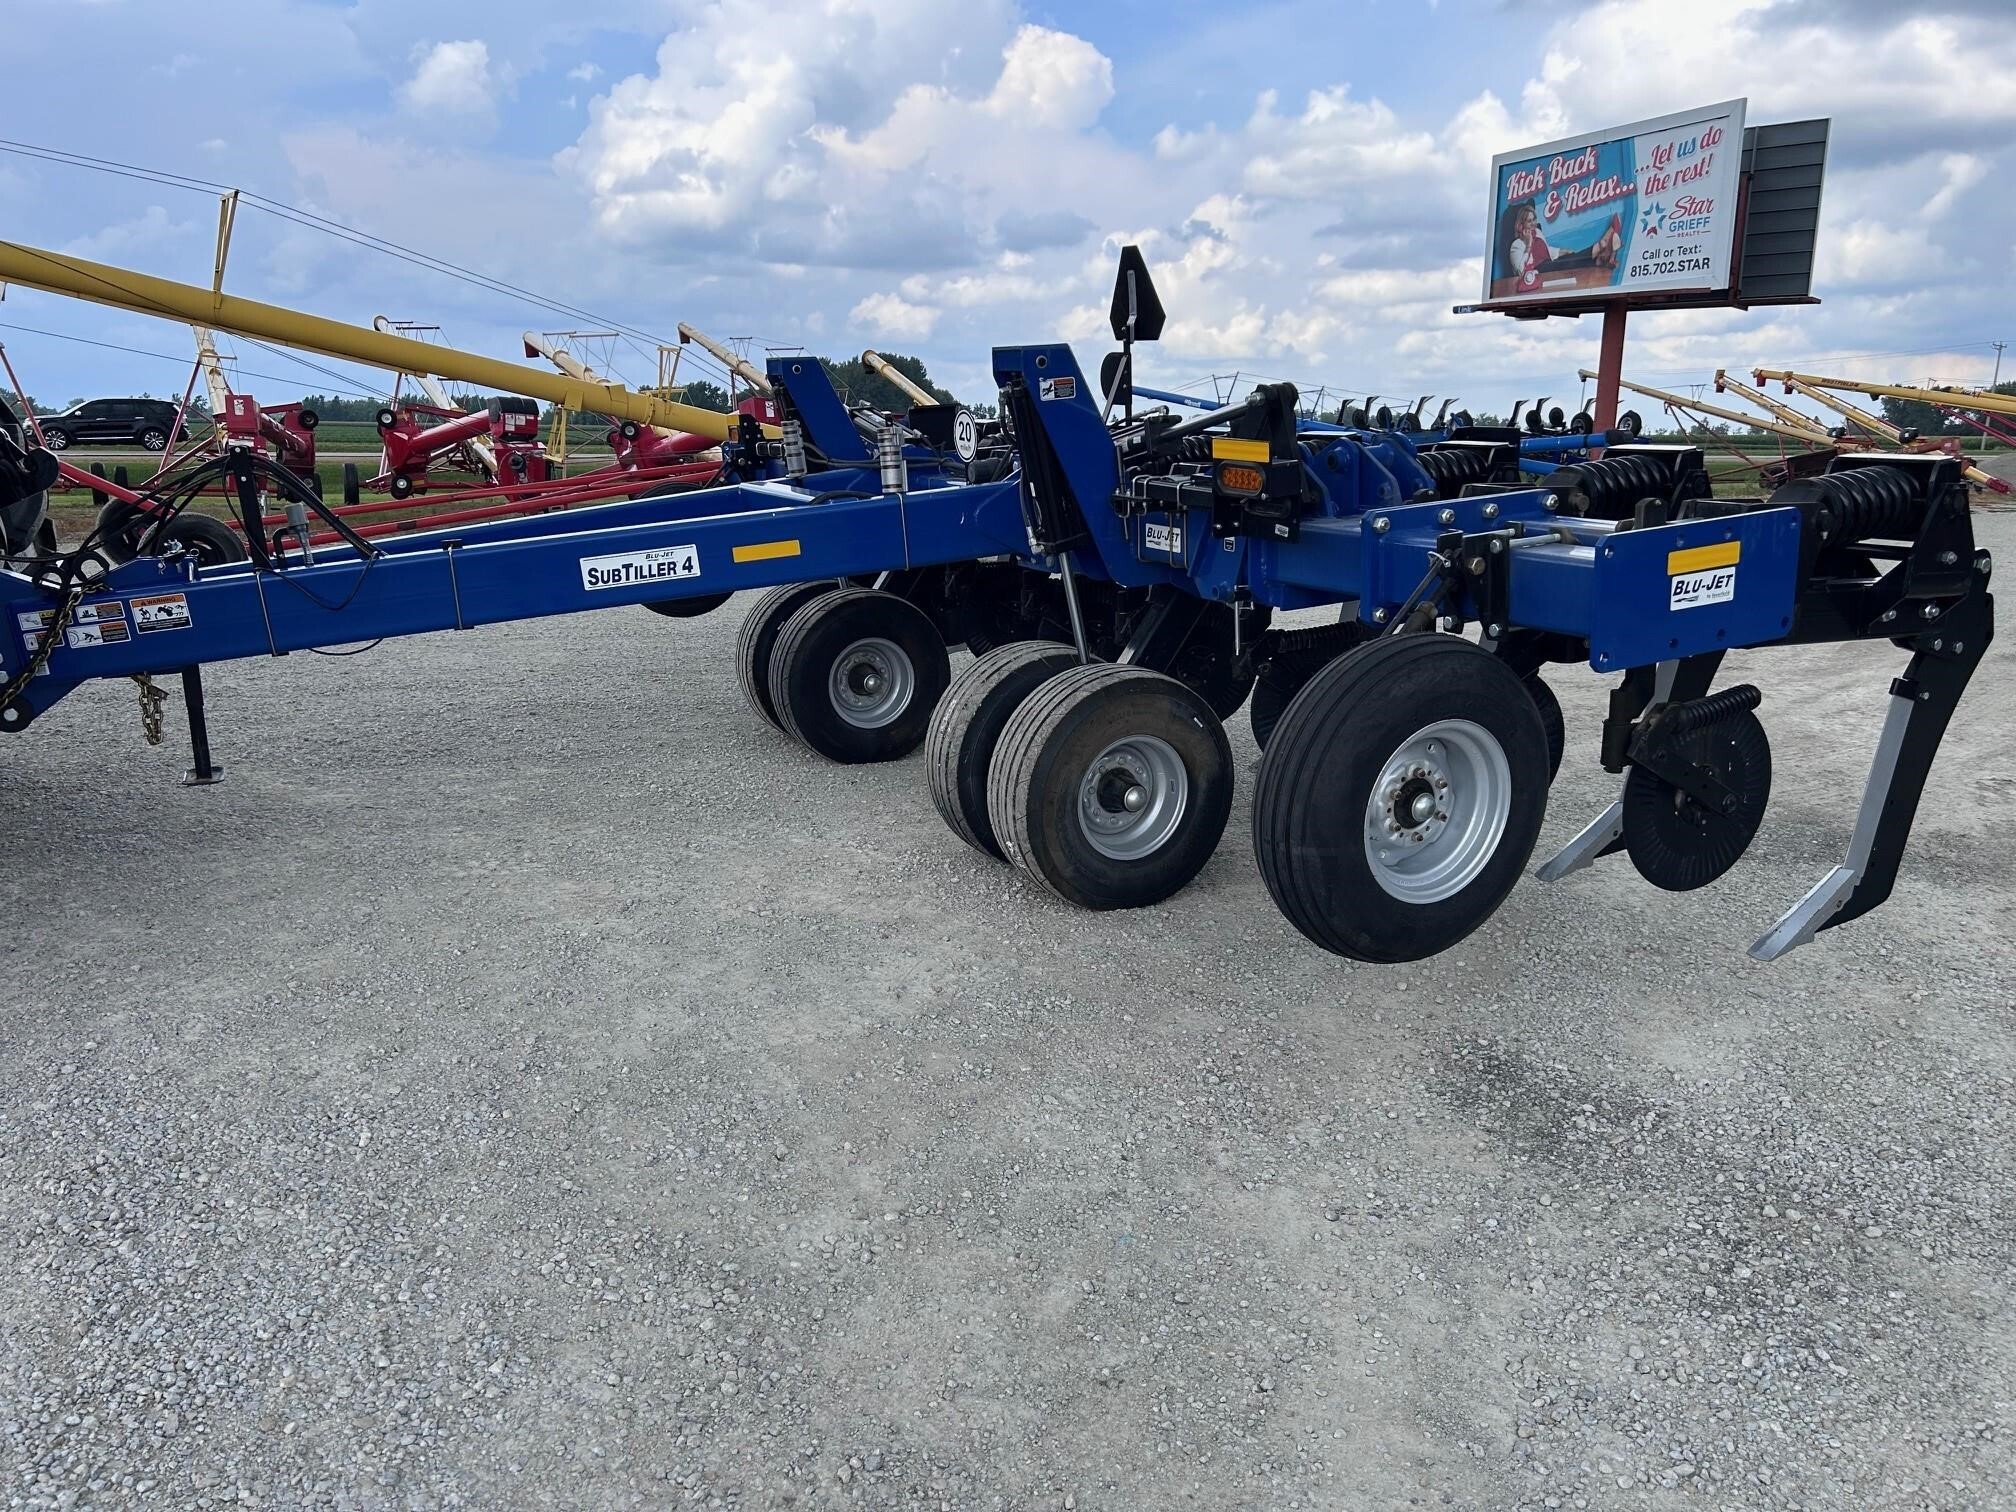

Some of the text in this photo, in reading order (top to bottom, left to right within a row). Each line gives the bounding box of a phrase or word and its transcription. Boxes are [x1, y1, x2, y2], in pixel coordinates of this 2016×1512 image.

[1677, 137, 1697, 158] us
[1700, 125, 1723, 149] do
[1507, 146, 1597, 201] Kick Back
[1645, 153, 1714, 196] the rest!
[1544, 175, 1635, 219] & Relax...
[1669, 195, 1714, 219] Star
[1669, 216, 1711, 232] GRIEFF
[1642, 244, 1702, 260] Call or Text:
[1630, 257, 1711, 277] 815.702.STAR
[959, 421, 971, 442] 20
[645, 551, 674, 559] BLU-JET
[682, 556, 694, 573] 4
[1673, 574, 1734, 597] BLU-JET
